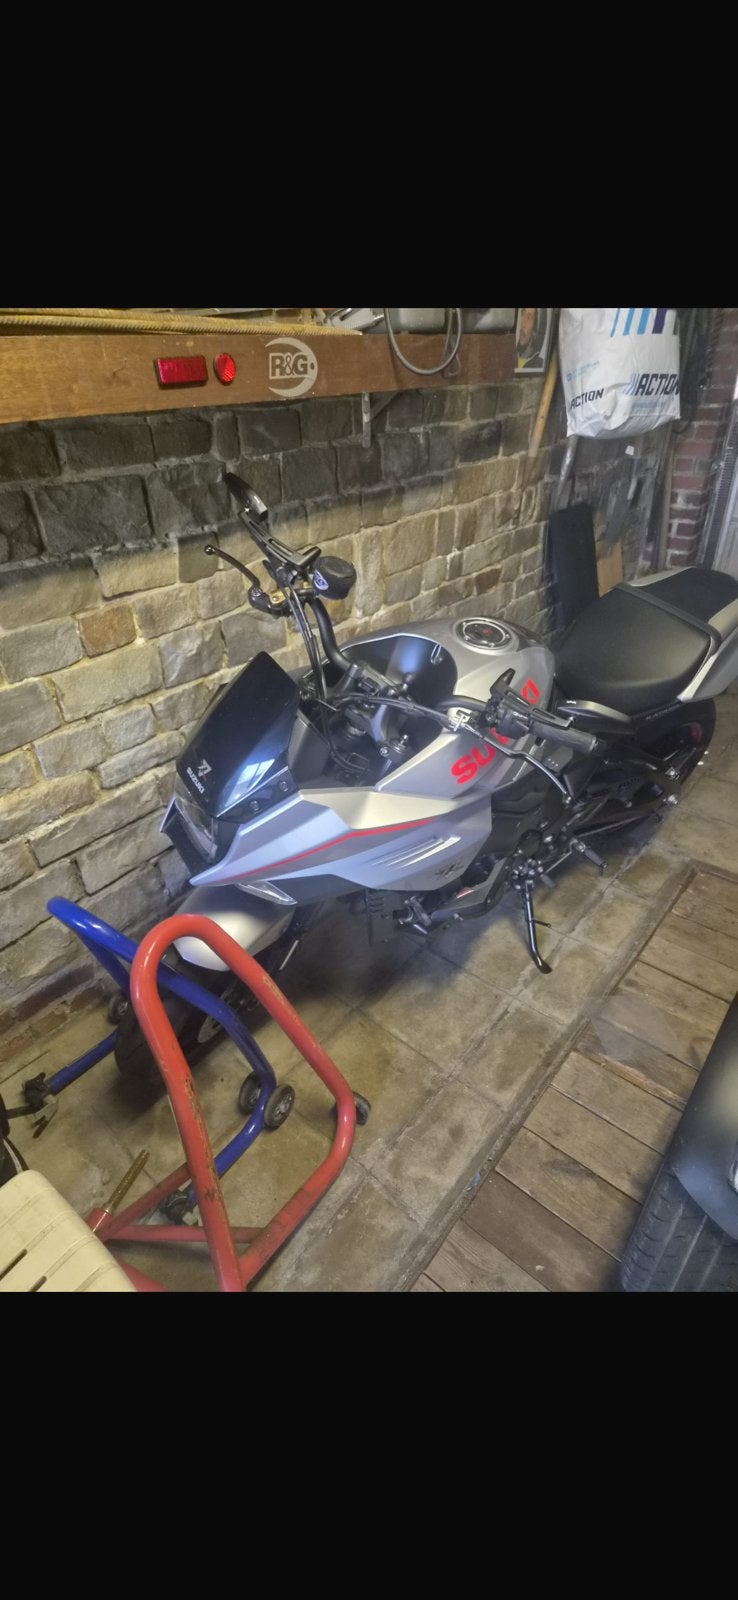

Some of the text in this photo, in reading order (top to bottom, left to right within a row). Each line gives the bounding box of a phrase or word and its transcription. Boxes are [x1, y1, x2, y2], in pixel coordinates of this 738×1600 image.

[270, 353, 308, 377] R&G
[569, 388, 605, 410] ACTION
[450, 678, 540, 785] SUI
[187, 766, 205, 795] SUZUKI
